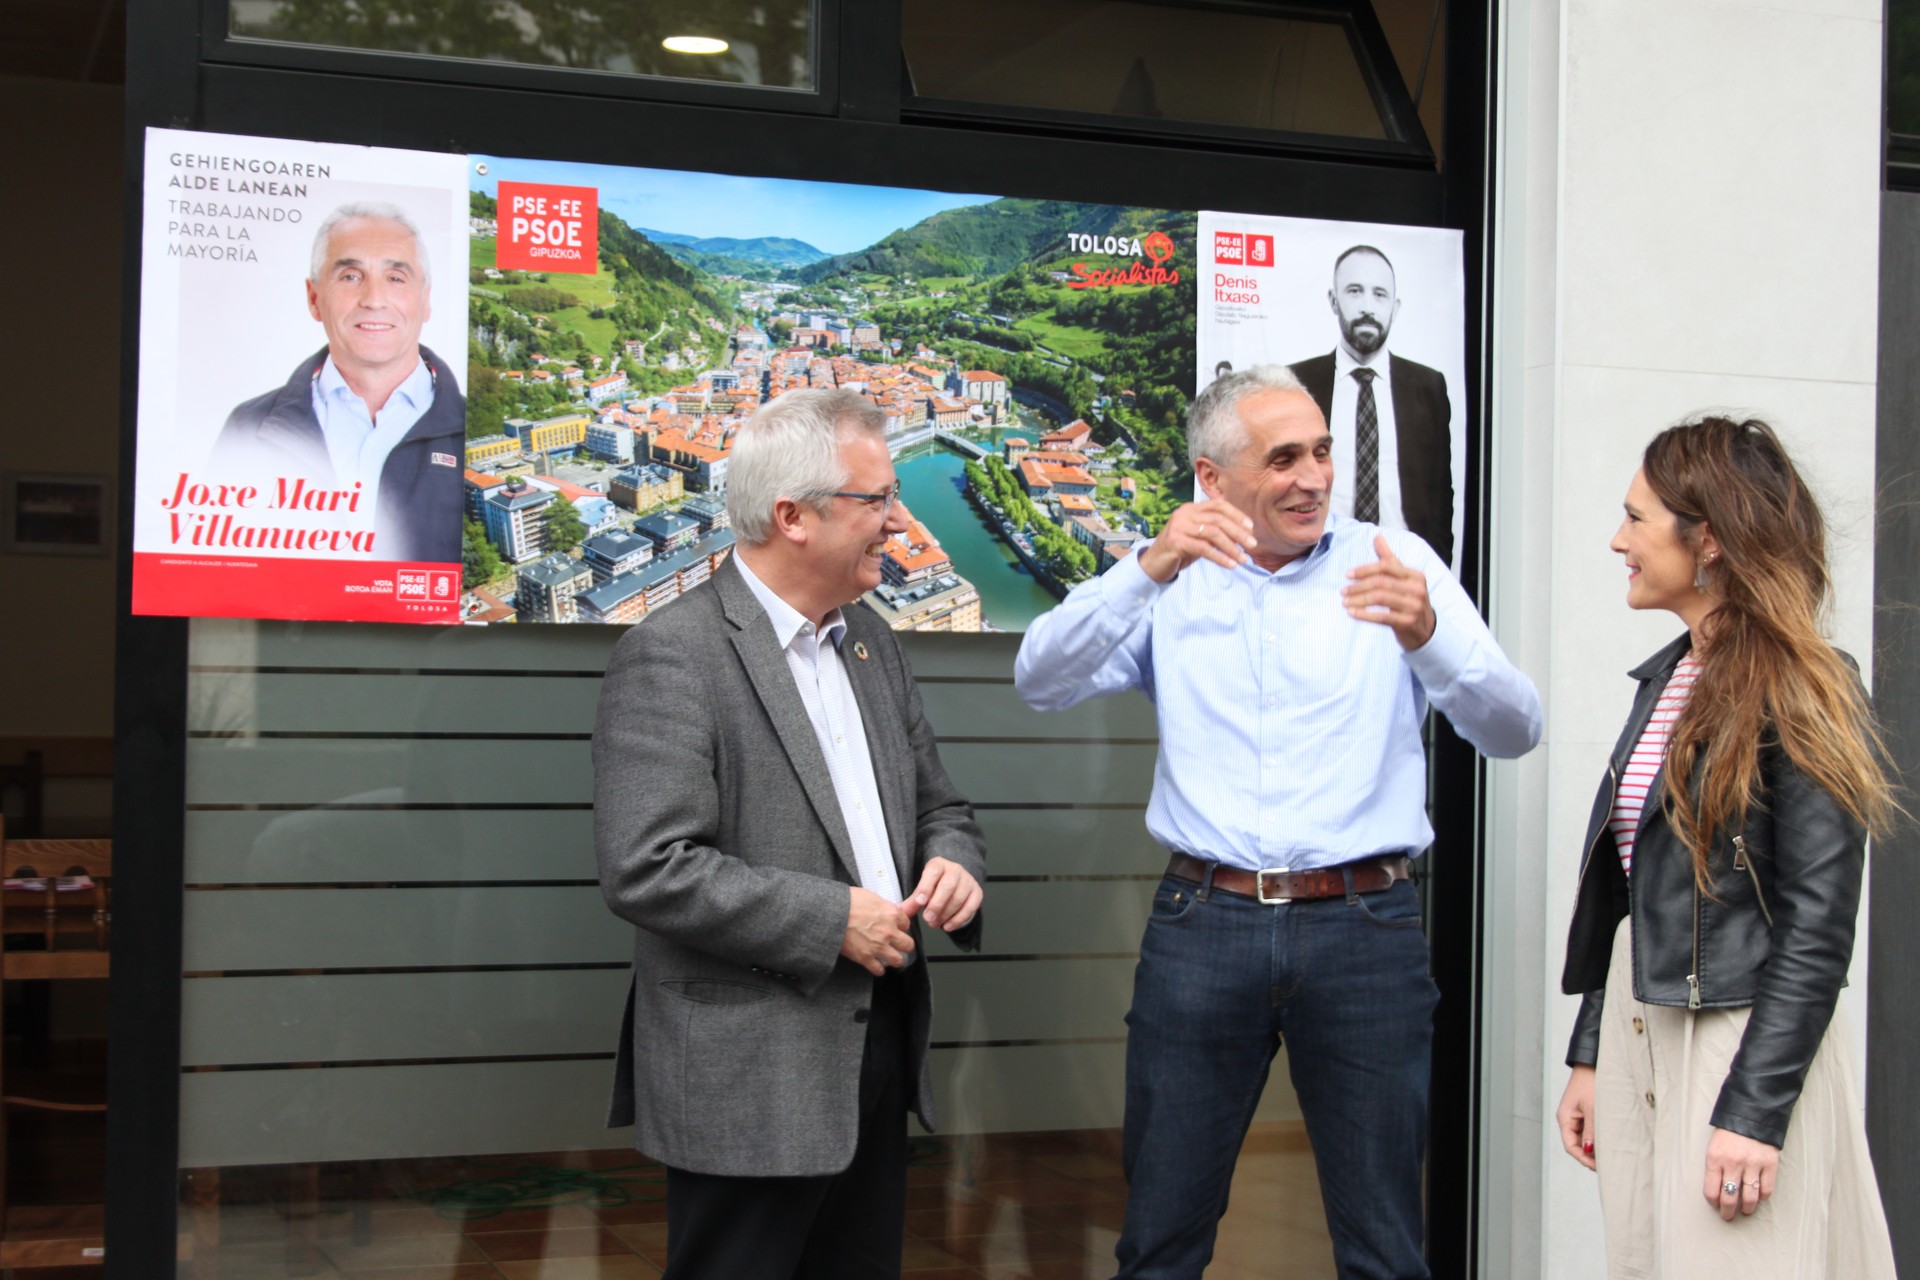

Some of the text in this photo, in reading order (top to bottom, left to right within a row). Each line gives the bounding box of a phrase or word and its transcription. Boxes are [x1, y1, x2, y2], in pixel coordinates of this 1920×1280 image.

[170, 152, 331, 179] GEHIENGOAREN
[169, 175, 308, 198] ALDE LANEAN
[168, 199, 303, 224] TRABAJANDO
[168, 221, 250, 241] PARA LA
[512, 217, 582, 247] PSOE
[1216, 236, 1242, 247] PSE-EE
[167, 243, 259, 264] MAYORÍA
[530, 247, 581, 259] GIPUZKOA
[1067, 232, 1143, 257] TOLOSA
[1216, 246, 1242, 260] PSOE
[1067, 261, 1179, 289] Socialistas
[1215, 273, 1258, 290] Denis
[1215, 288, 1260, 305] Itxaso
[161, 472, 363, 513] Joxe Mari
[167, 513, 375, 552] Villanueva
[400, 574, 425, 583] PSE-EE
[400, 584, 425, 594] PSOE
